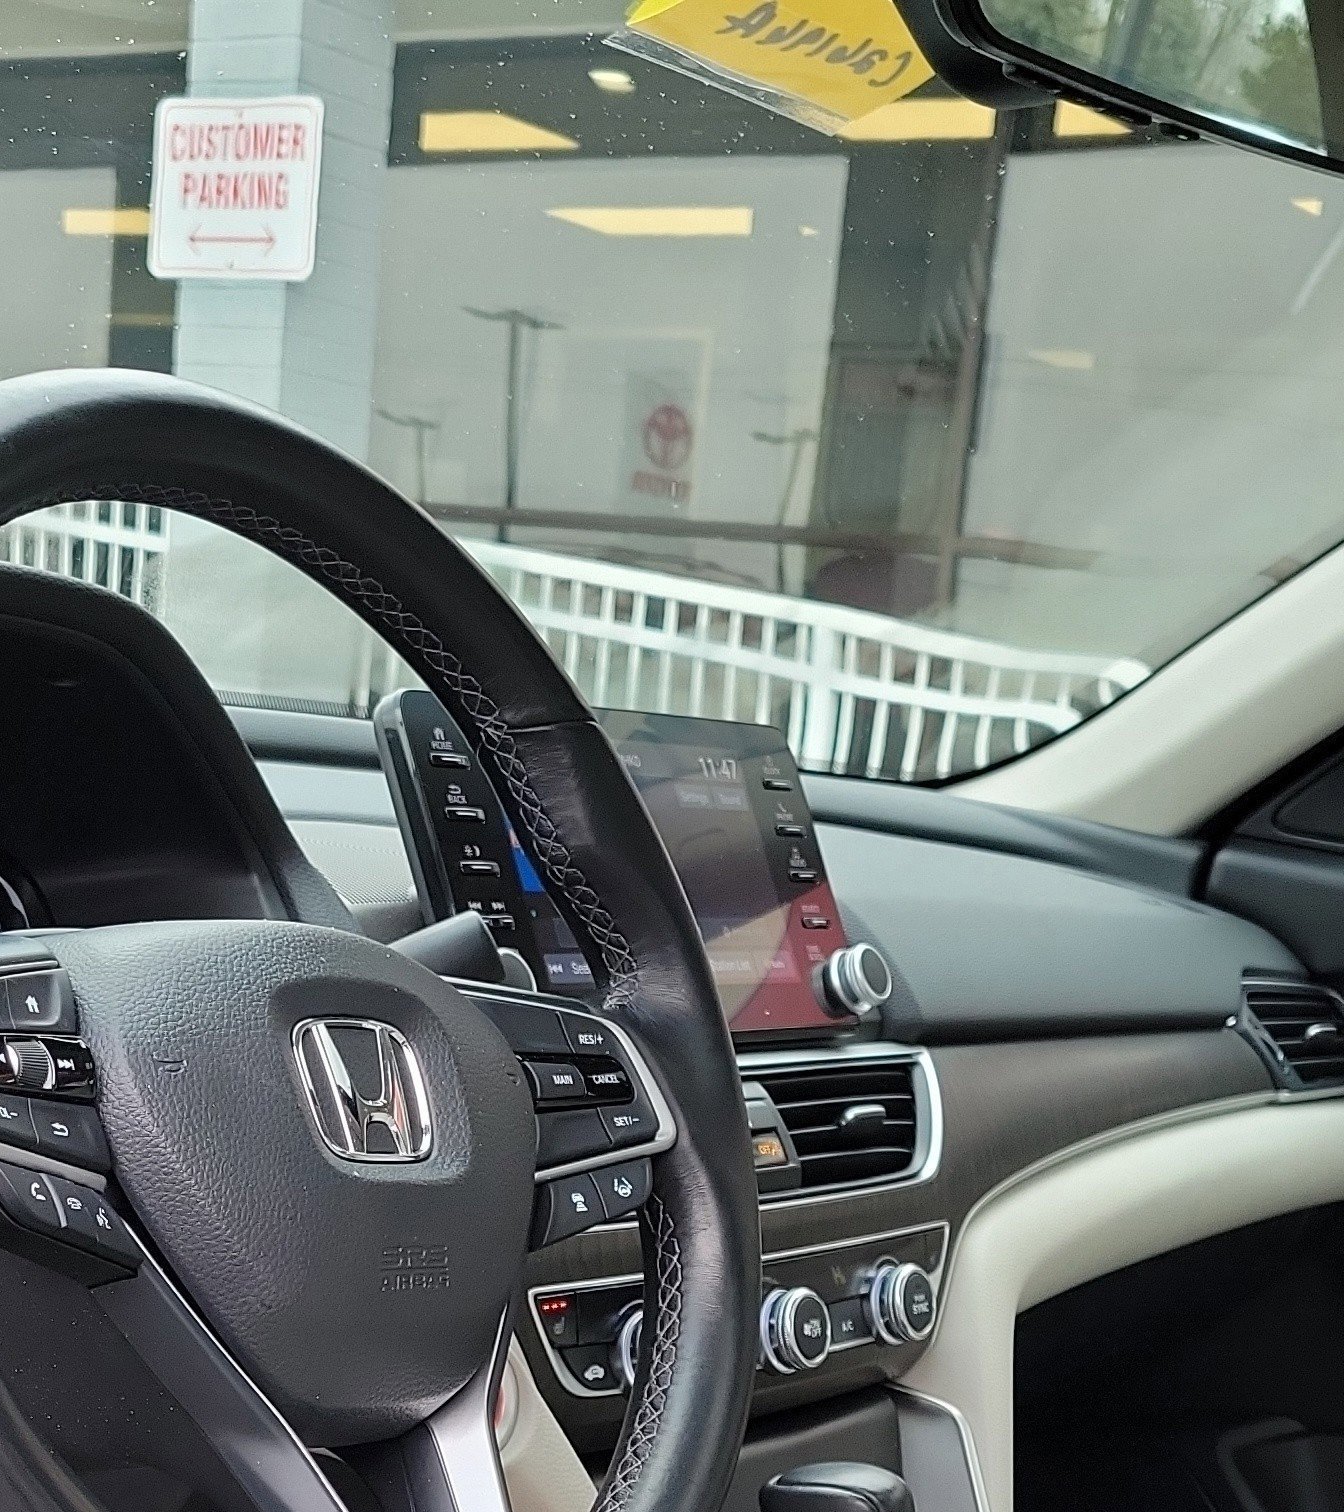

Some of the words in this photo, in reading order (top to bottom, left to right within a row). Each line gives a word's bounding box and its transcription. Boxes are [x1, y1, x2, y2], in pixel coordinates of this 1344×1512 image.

[171, 123, 305, 161] CUSTOMER
[182, 172, 289, 209] PARKING
[698, 757, 737, 780] 11:47
[552, 1074, 574, 1086] MAIN
[592, 1074, 621, 1086] CANCEL
